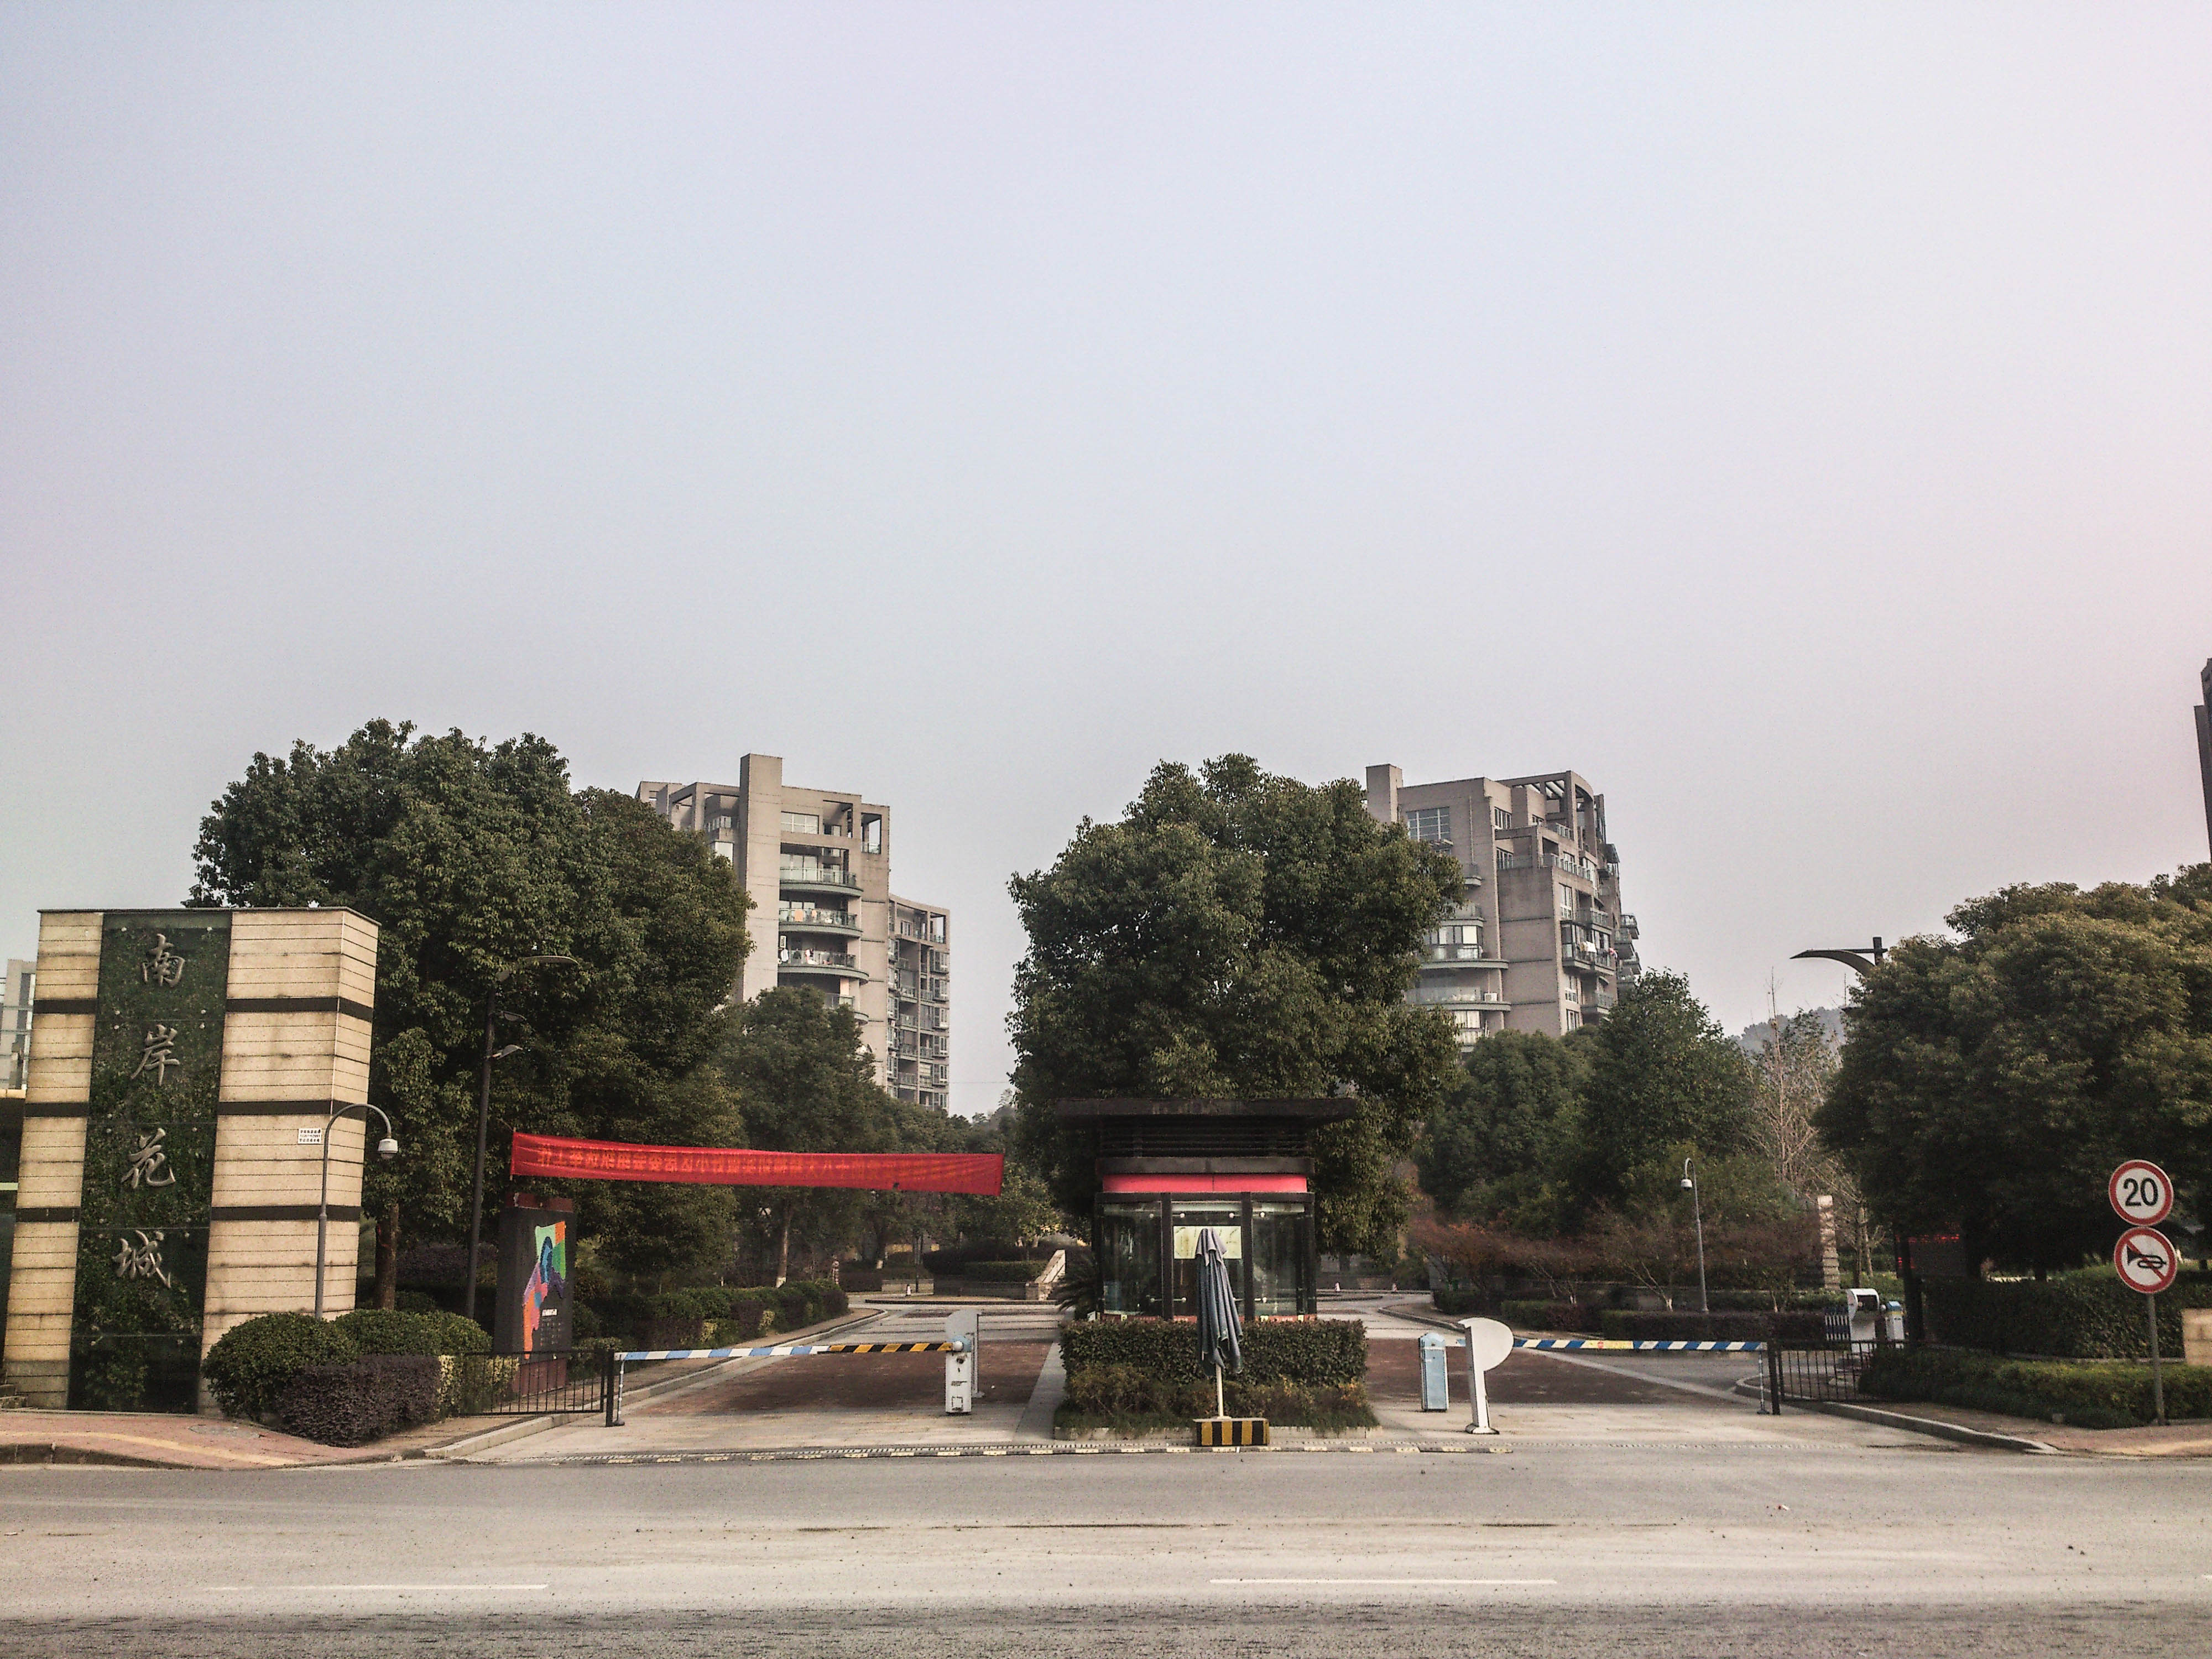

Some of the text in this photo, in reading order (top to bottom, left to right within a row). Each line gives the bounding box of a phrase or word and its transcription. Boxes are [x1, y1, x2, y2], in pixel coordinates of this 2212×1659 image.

[112, 933, 185, 1288] 南岸花城
[2124, 1178, 2158, 1206] 20
